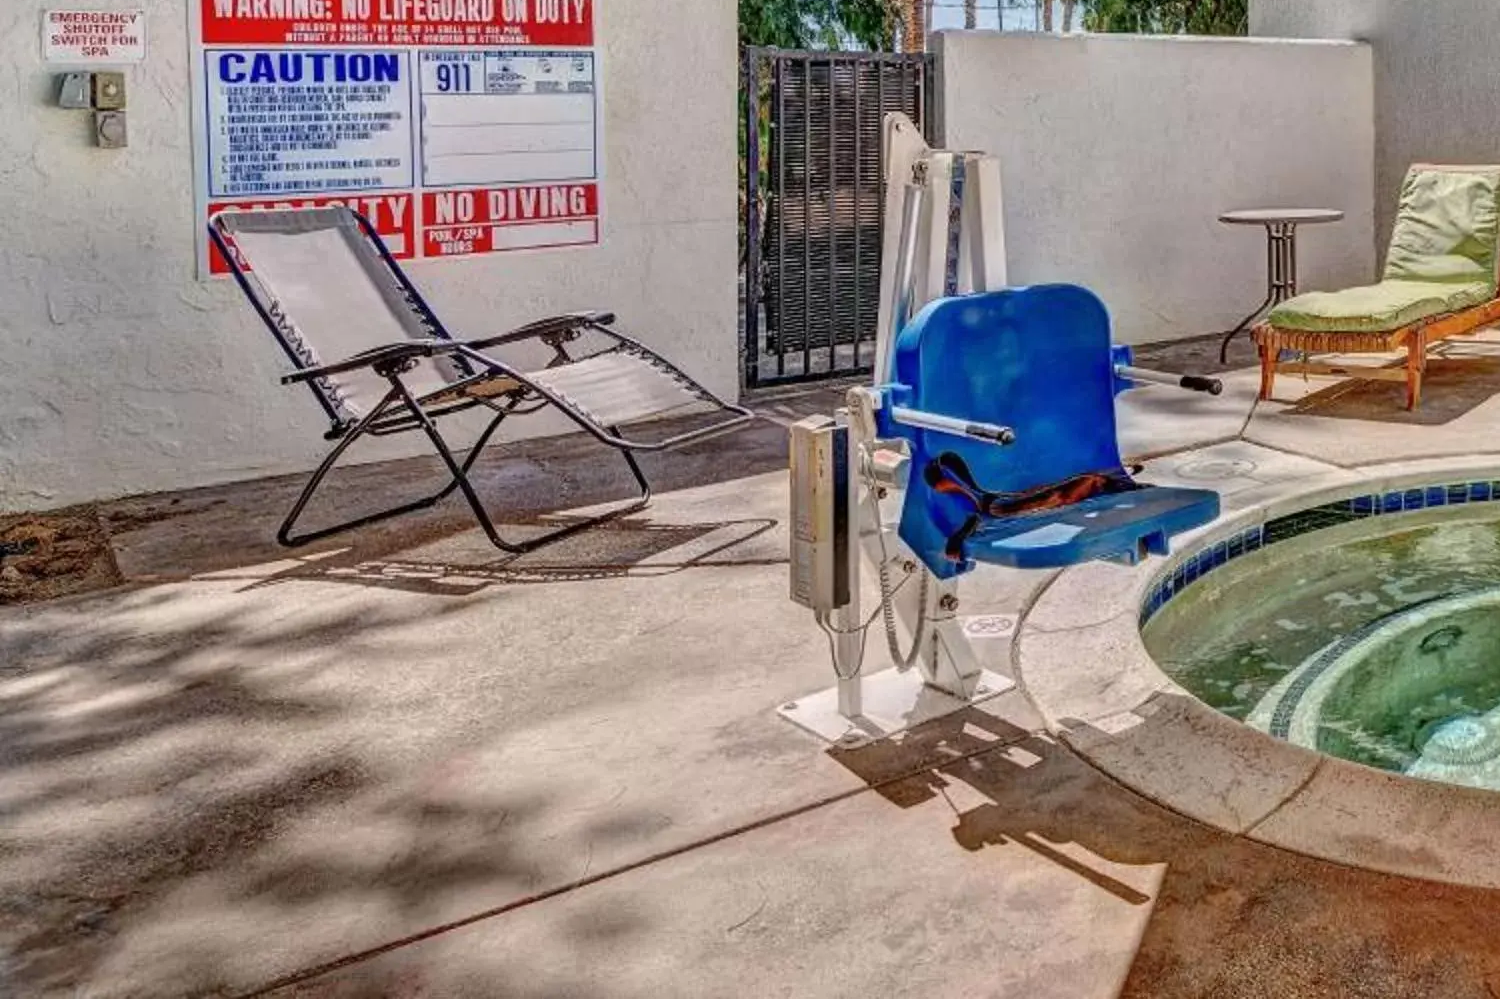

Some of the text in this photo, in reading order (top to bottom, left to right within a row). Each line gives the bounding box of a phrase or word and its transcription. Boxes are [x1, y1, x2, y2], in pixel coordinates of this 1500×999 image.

[50, 12, 137, 23] EMERGENCY
[63, 24, 125, 34] SHUTOFF
[51, 35, 138, 46] SWITCH FOR
[81, 46, 109, 56] SPA
[219, 53, 400, 84] CAUTION
[436, 63, 471, 92] 911
[435, 193, 475, 224] NO
[488, 186, 587, 220] DIVING
[429, 226, 485, 242] POOL/SPA
